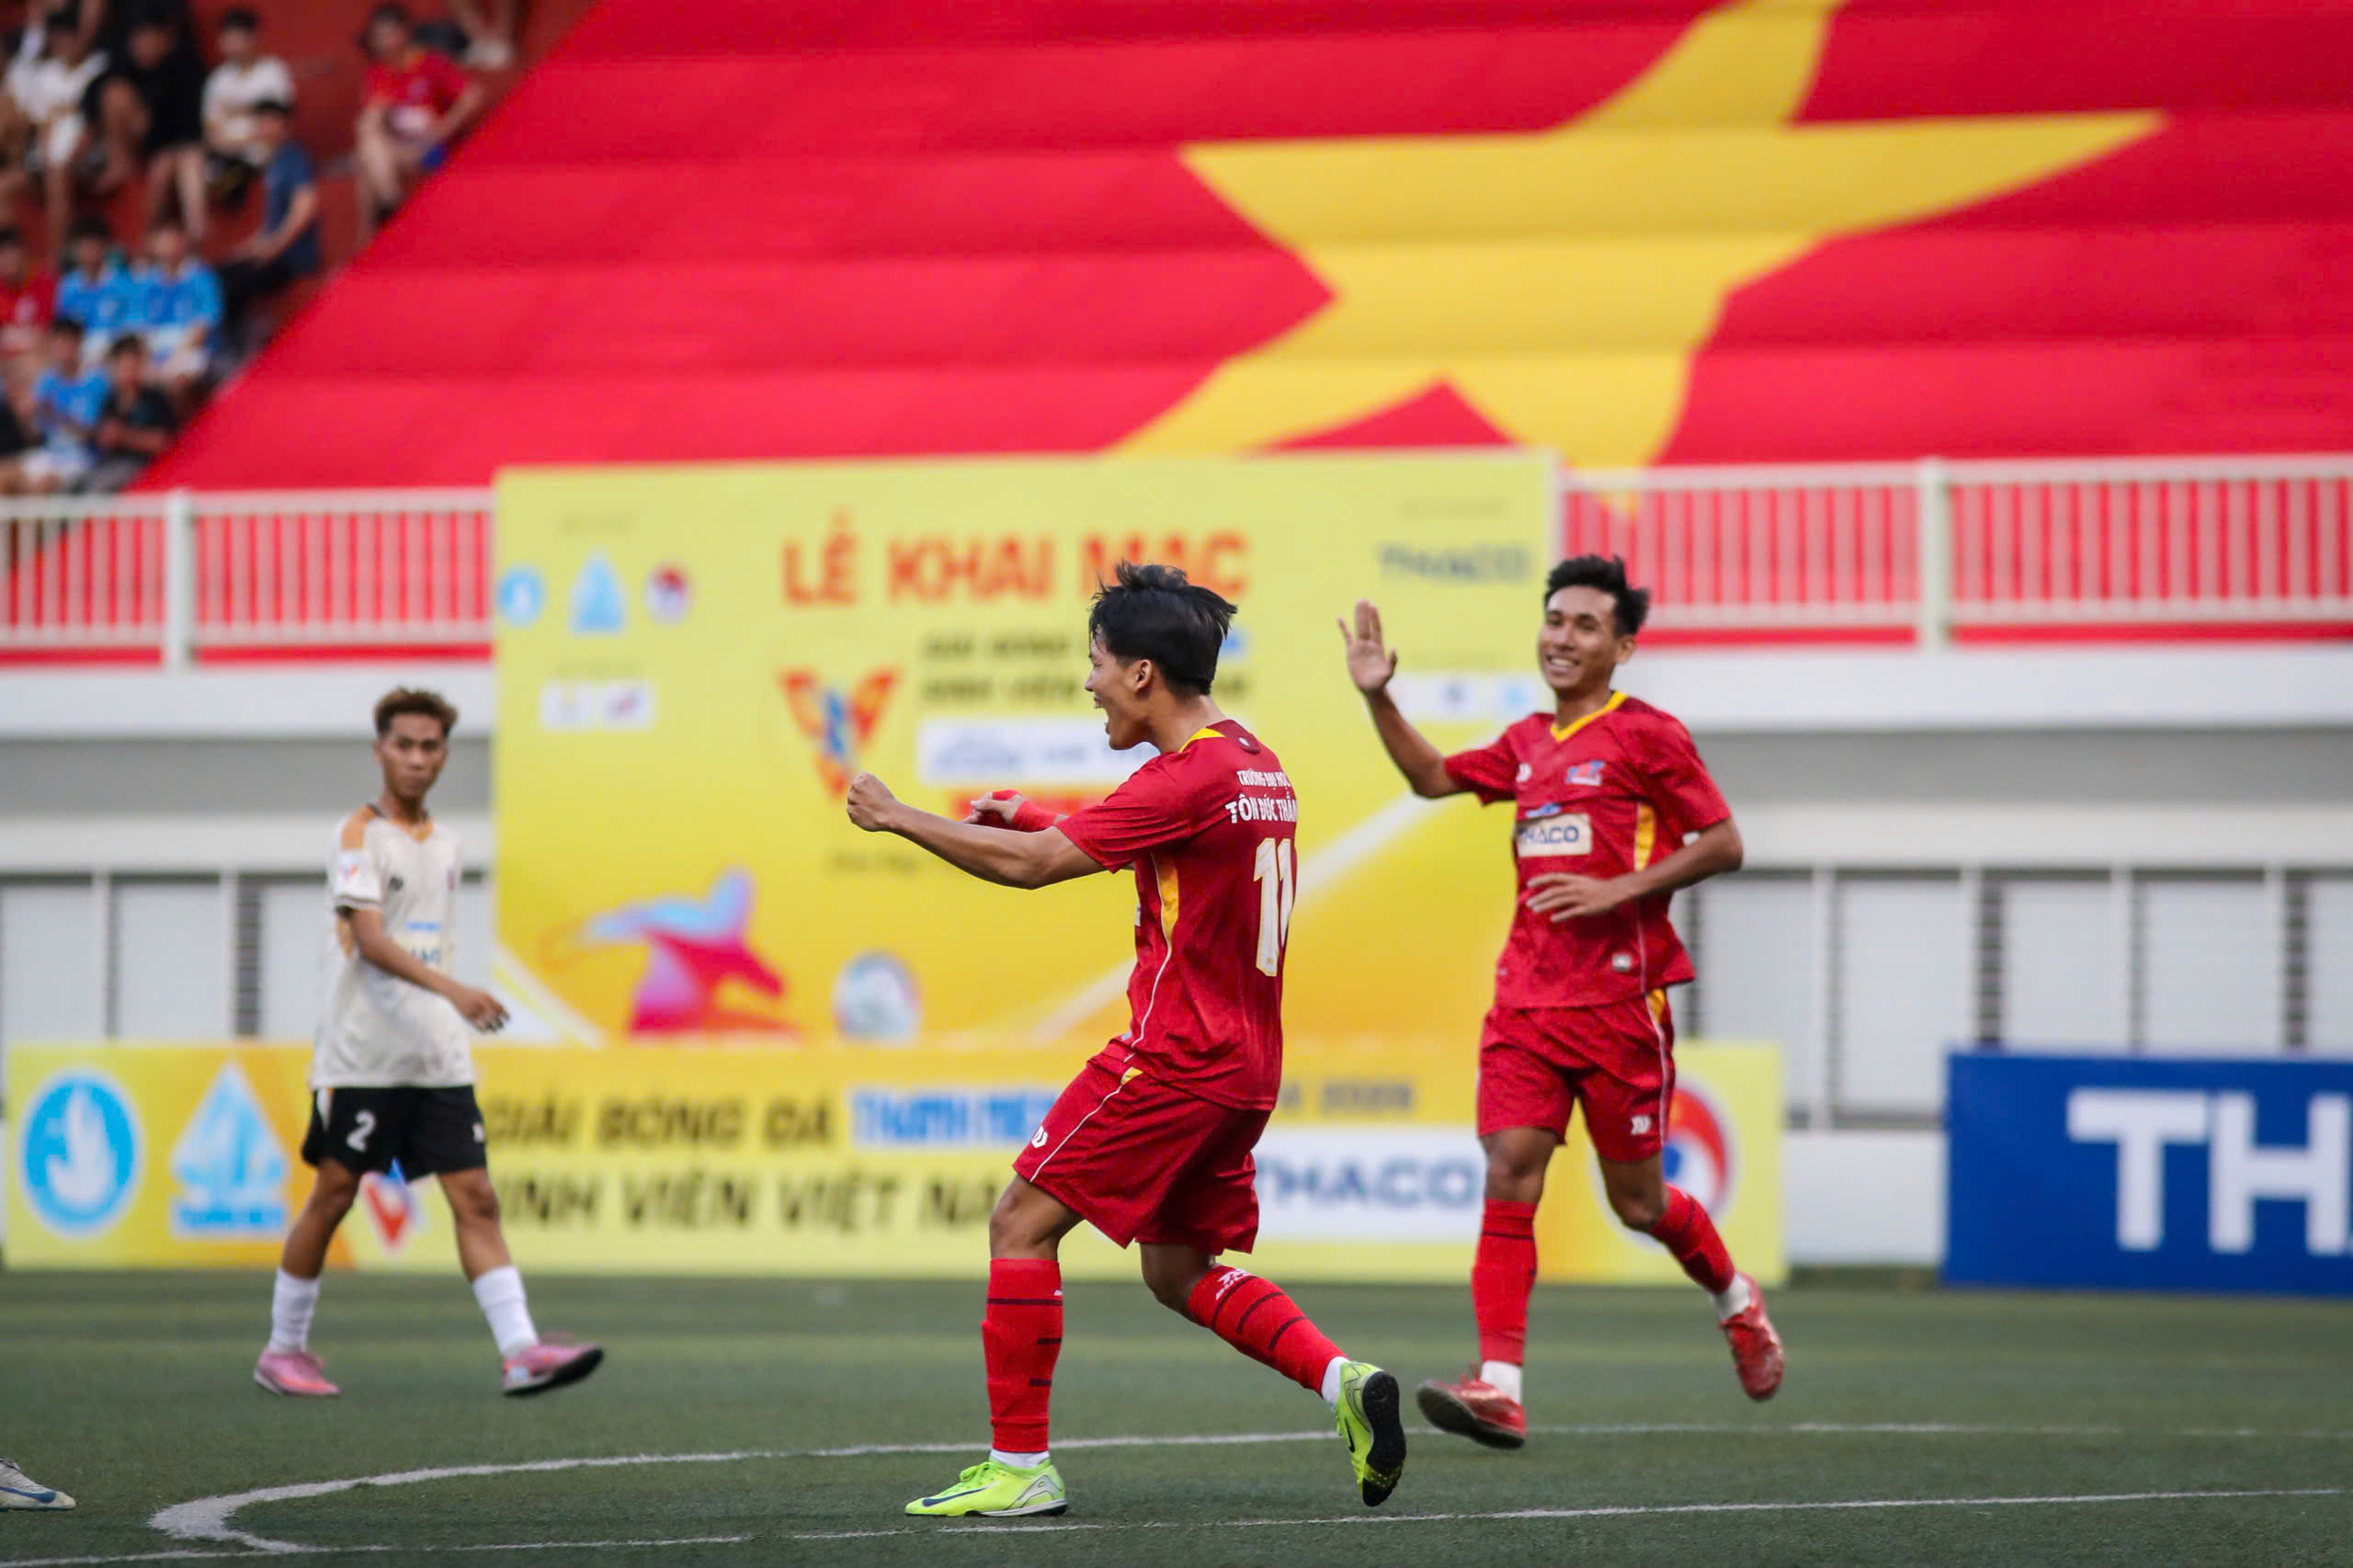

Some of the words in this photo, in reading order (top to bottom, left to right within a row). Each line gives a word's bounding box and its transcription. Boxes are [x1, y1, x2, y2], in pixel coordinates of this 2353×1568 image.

[888, 536, 1054, 603] KHAI
[1224, 793, 1259, 824] TÔN
[1254, 837, 1293, 977] 11
[347, 1110, 376, 1152] 2
[497, 1173, 602, 1226] INH
[919, 1174, 998, 1227] NA
[2066, 1086, 2353, 1256] TH
